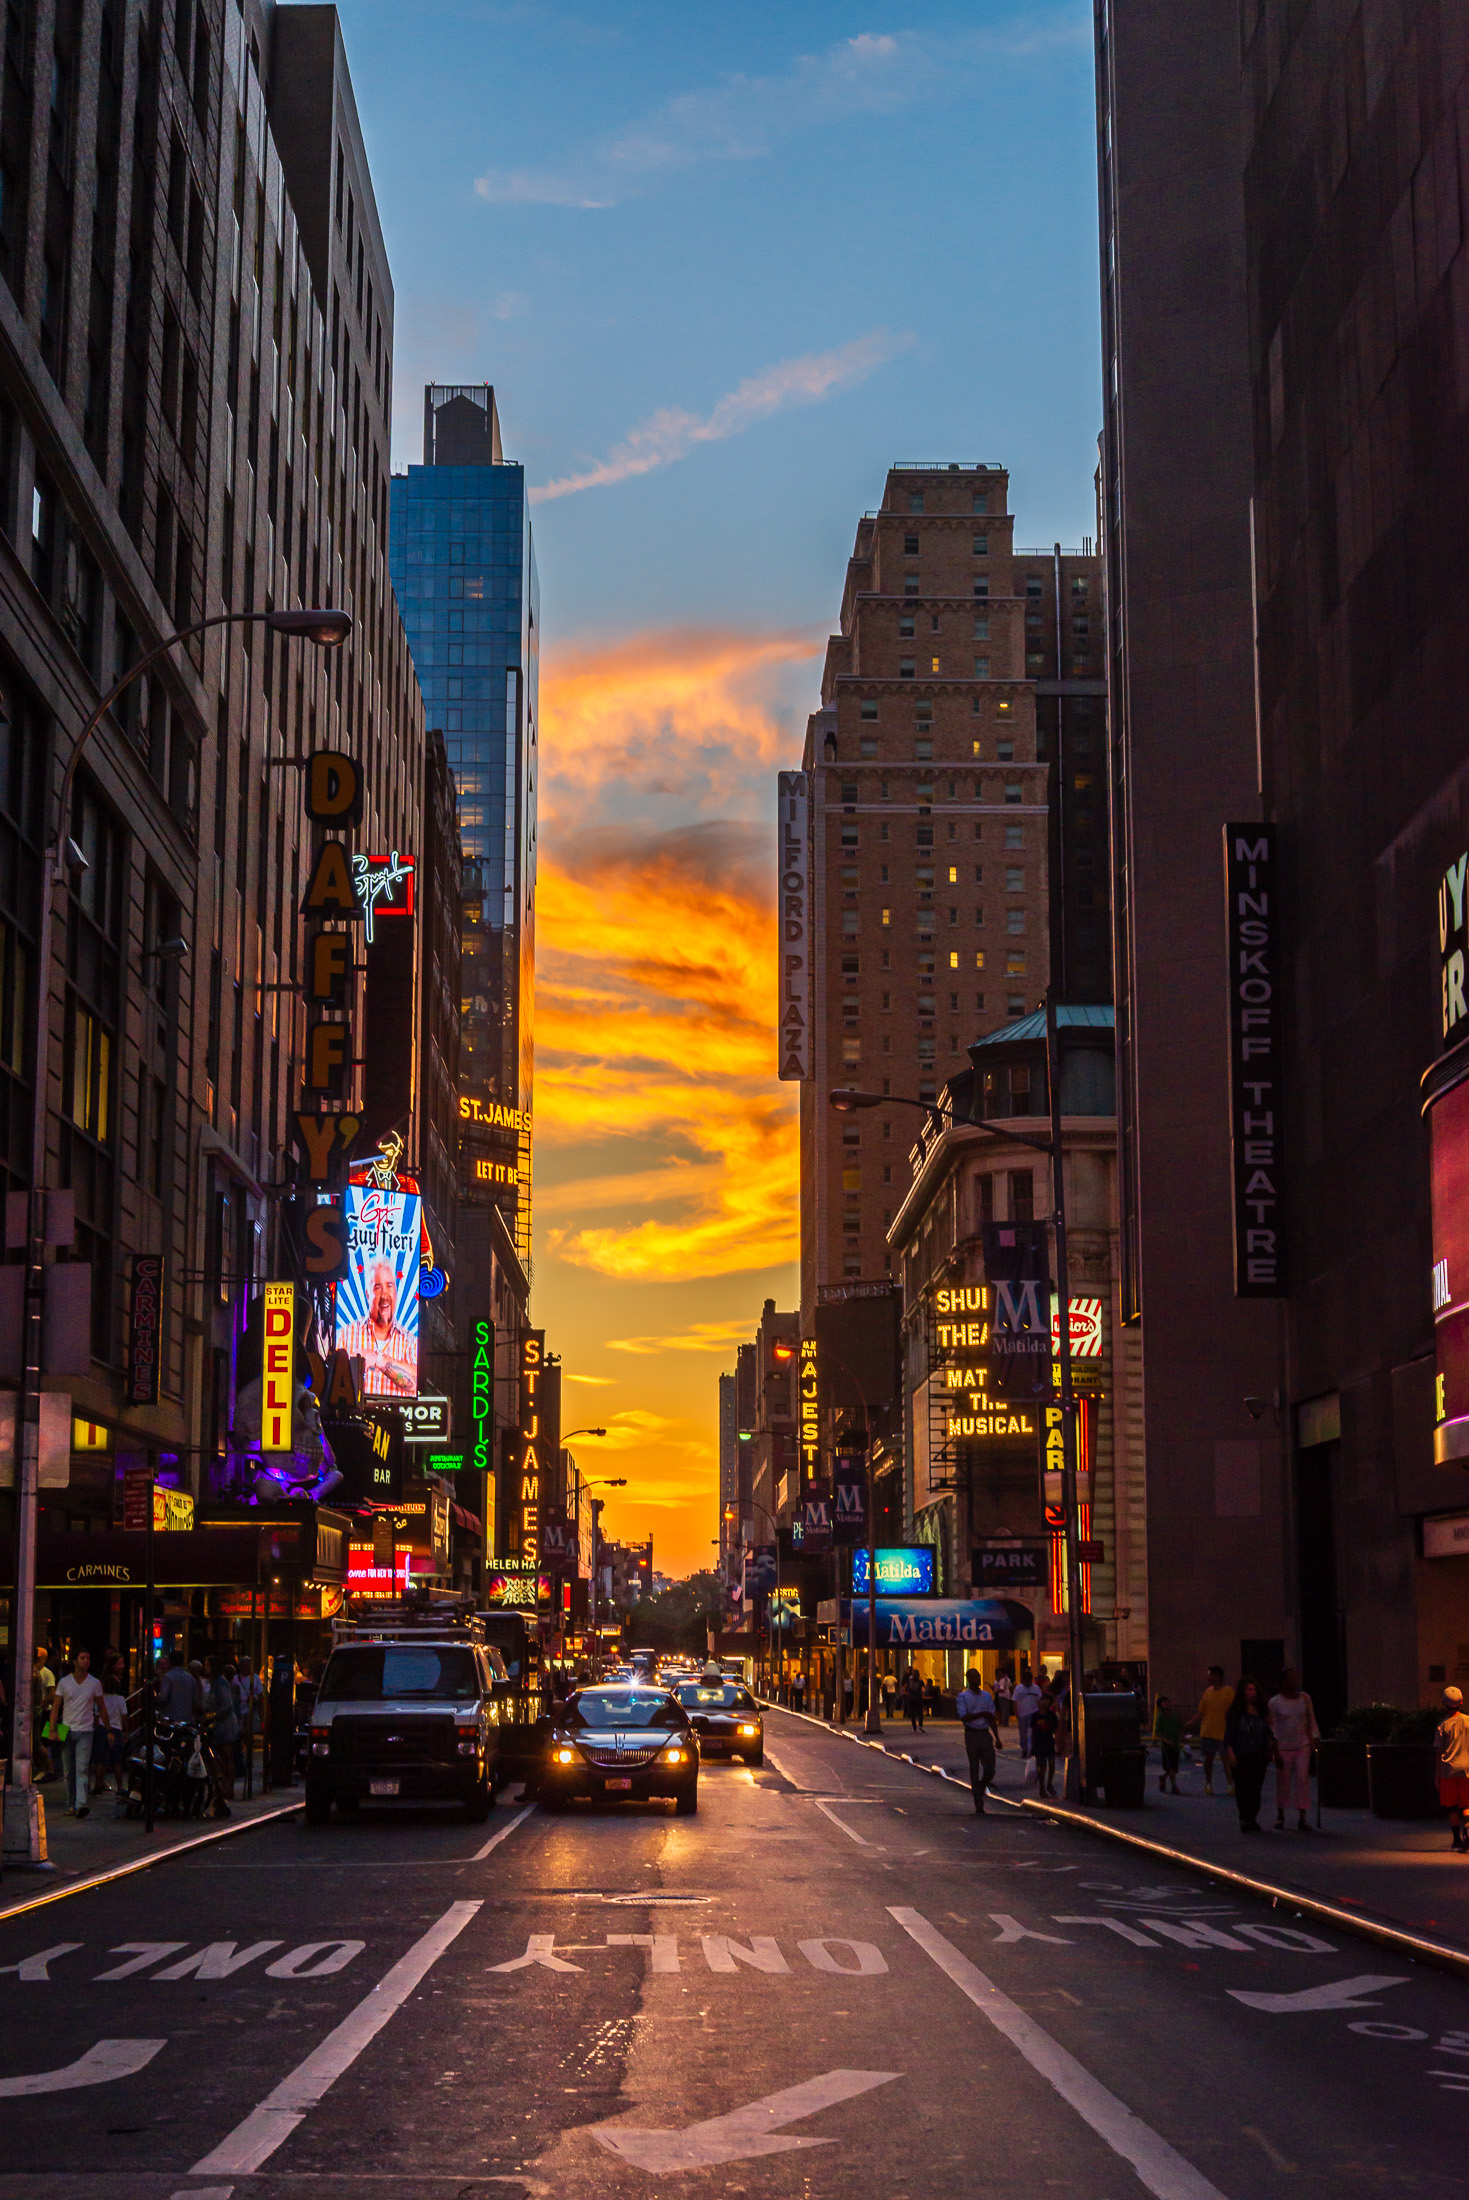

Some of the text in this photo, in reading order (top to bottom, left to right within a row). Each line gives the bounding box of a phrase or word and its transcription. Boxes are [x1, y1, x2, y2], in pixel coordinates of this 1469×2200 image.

[780, 775, 805, 1077] MILFORD PLAZA
[300, 752, 359, 1273] DAFFY'S
[1236, 838, 1277, 1284] MINSKOFF THEATRE
[477, 1160, 519, 1185] LET IT BE
[266, 1287, 293, 1296] STAR
[268, 1297, 290, 1305] LITE
[936, 1287, 988, 1313] SHU
[990, 1280, 1048, 1334] M
[133, 1260, 158, 1400] CARMINES
[992, 1336, 1048, 1354] Matilda
[265, 1308, 292, 1445] DELI
[473, 1321, 490, 1468] SARDI'S
[948, 1415, 1034, 1436] MUSICAL
[1045, 1407, 1065, 1472] PAR
[373, 1468, 391, 1484] BAR
[834, 1484, 865, 1512] M
[804, 1502, 830, 1526] M
[485, 1559, 519, 1569] HELEN
[864, 1561, 922, 1580] Matilda
[981, 1553, 1037, 1568] PARK
[503, 1576, 536, 1592] ROCK
[888, 1613, 994, 1642] Matilda
[988, 1914, 1340, 1953] ONLY
[0, 1940, 366, 1981] ONLY
[485, 1934, 890, 1975] ONLY
